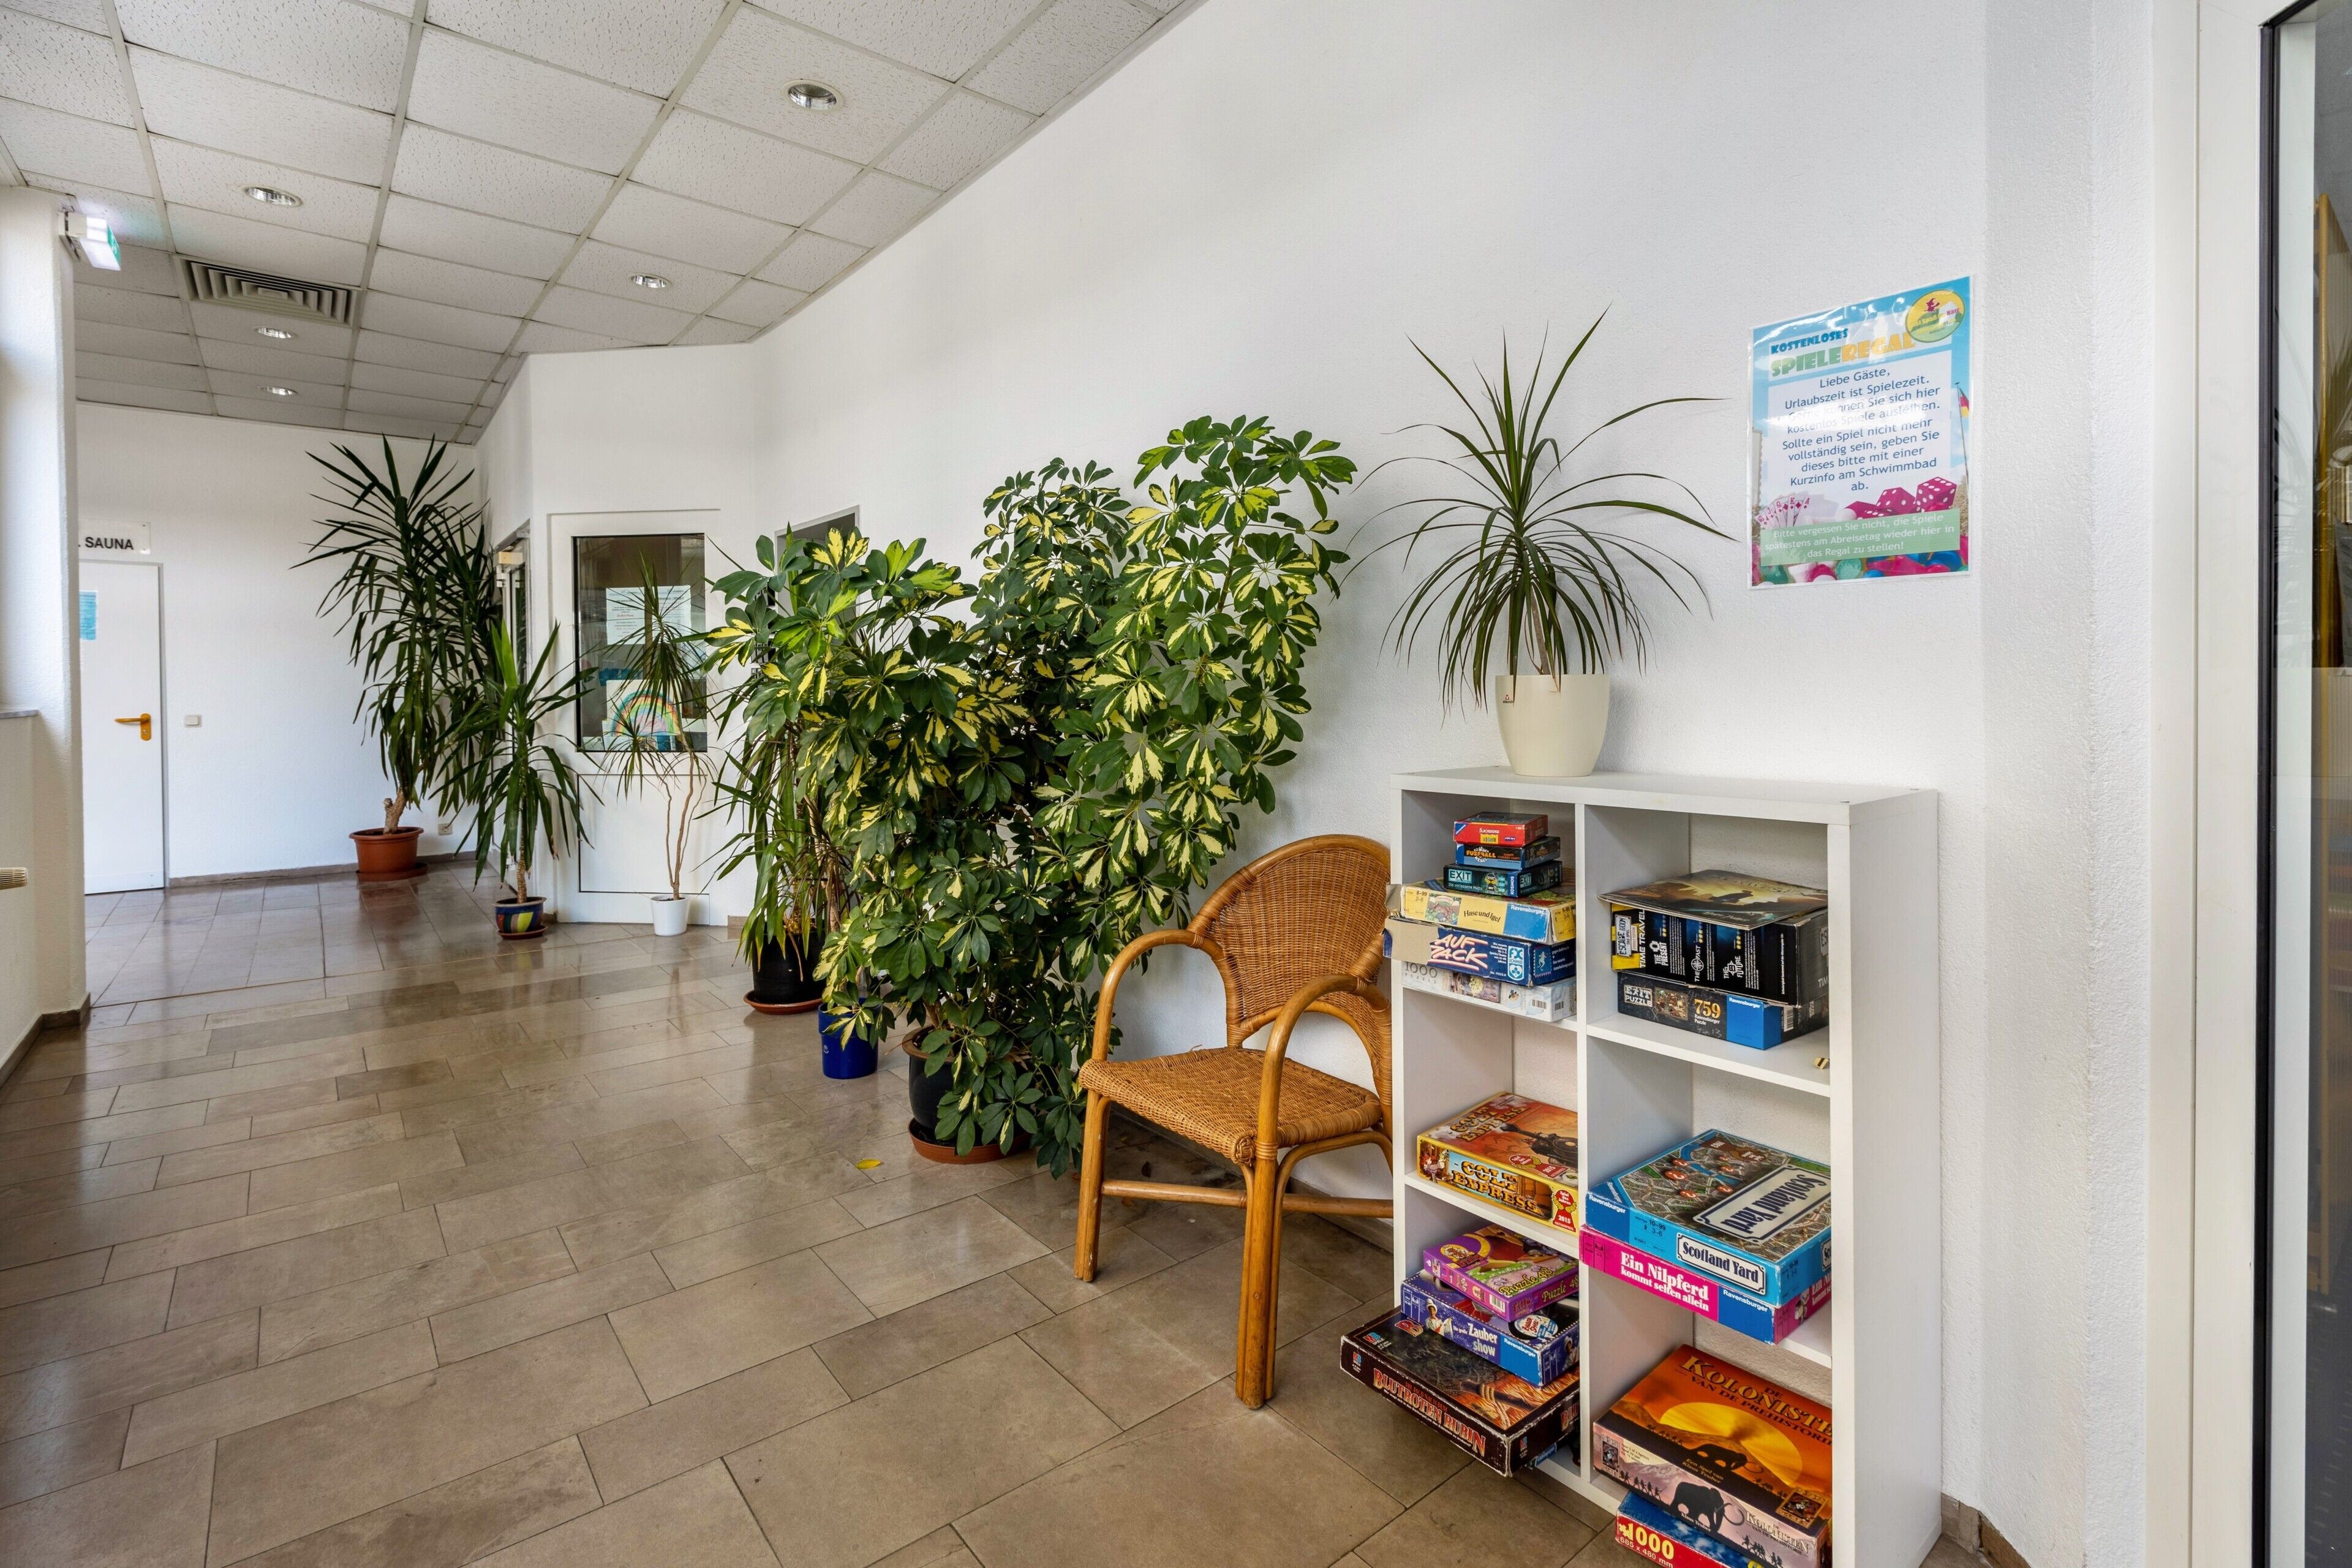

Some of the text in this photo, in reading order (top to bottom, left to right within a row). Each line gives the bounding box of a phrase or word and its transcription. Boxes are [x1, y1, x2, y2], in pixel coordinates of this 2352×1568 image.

[1771, 328, 1849, 354] KOSTENLOSES
[1820, 369, 1890, 388] Liebe Gäste,
[1785, 375, 1929, 409] Urlaubszeit ist Spielezeit.
[1868, 388, 1940, 407] Sie sich hier
[1787, 402, 1940, 434] kostenlos Spiele ausleihen.
[1782, 419, 1932, 450] Sollte ein Spiel nicht mehr
[1789, 431, 1940, 461] vollständig sein, geben Sie
[1790, 458, 1937, 486] Kurzinfo am Schwimmbad
[1801, 448, 1924, 472] dieses bitte mit einer
[1851, 481, 1868, 491] ab.
[1798, 525, 1842, 536] vergessen
[1893, 517, 1909, 526] die
[1912, 514, 1944, 525] Spiele
[85, 537, 134, 550] SAUNA
[1765, 540, 1811, 551] spätestens
[1831, 532, 1880, 544] Abreisetag
[1883, 529, 1917, 539] wieder
[1921, 527, 1941, 535] hier
[1825, 546, 1850, 556] Regal
[1868, 541, 1904, 552] stellen!
[1449, 870, 1471, 881] EXIT
[1489, 912, 1501, 922] Igel
[1434, 933, 1488, 949] AUF
[1618, 930, 1627, 955] ESCAPE
[1659, 941, 1669, 966] PRESENT
[1405, 961, 1438, 978] 1000
[1735, 955, 1744, 978] FUTURE
[1625, 996, 1653, 1008] PUZZLE
[1694, 999, 1721, 1018] 759
[1729, 997, 1761, 1008] Ravensburger
[1694, 1014, 1721, 1024] Ravensburger
[1456, 1106, 1531, 1142] EXPRESS
[1461, 1161, 1520, 1192] COLT
[1452, 1170, 1540, 1213] EXPRESS
[1589, 1194, 1626, 1214] Ravensburger
[1721, 1174, 1827, 1234] Scotland Yard
[1558, 1215, 1571, 1224] 2015
[1683, 1242, 1730, 1272] Scotland
[1732, 1260, 1759, 1283] Yard
[1498, 1267, 1553, 1295] Puzzle 48
[1621, 1251, 1709, 1300] Ein Nilpferd
[1542, 1275, 1579, 1302] Puzzle 48
[1621, 1265, 1709, 1311] kommt selten allein
[1723, 1289, 1768, 1313] Ravensburger
[1468, 1322, 1498, 1344] Zauber
[1472, 1339, 1496, 1357] show
[1504, 1338, 1536, 1358] Ravensburger
[1691, 1376, 1716, 1392] VAN
[1719, 1390, 1739, 1402] DE
[1764, 1387, 1784, 1398] DE
[1373, 1368, 1443, 1425] BLUTROTEN
[1443, 1412, 1487, 1457] RUBIN
[1682, 1461, 1698, 1472] Klaus
[1686, 1458, 1698, 1466] Een
[1681, 1512, 1712, 1532] Klaus Teuber
[1746, 1510, 1809, 1554] KOLONISTEN
[1619, 1536, 1635, 1548] 685
[1642, 1548, 1656, 1561] 480
[1658, 1556, 1673, 1568] mm
[1626, 1523, 1675, 1560] 1000
